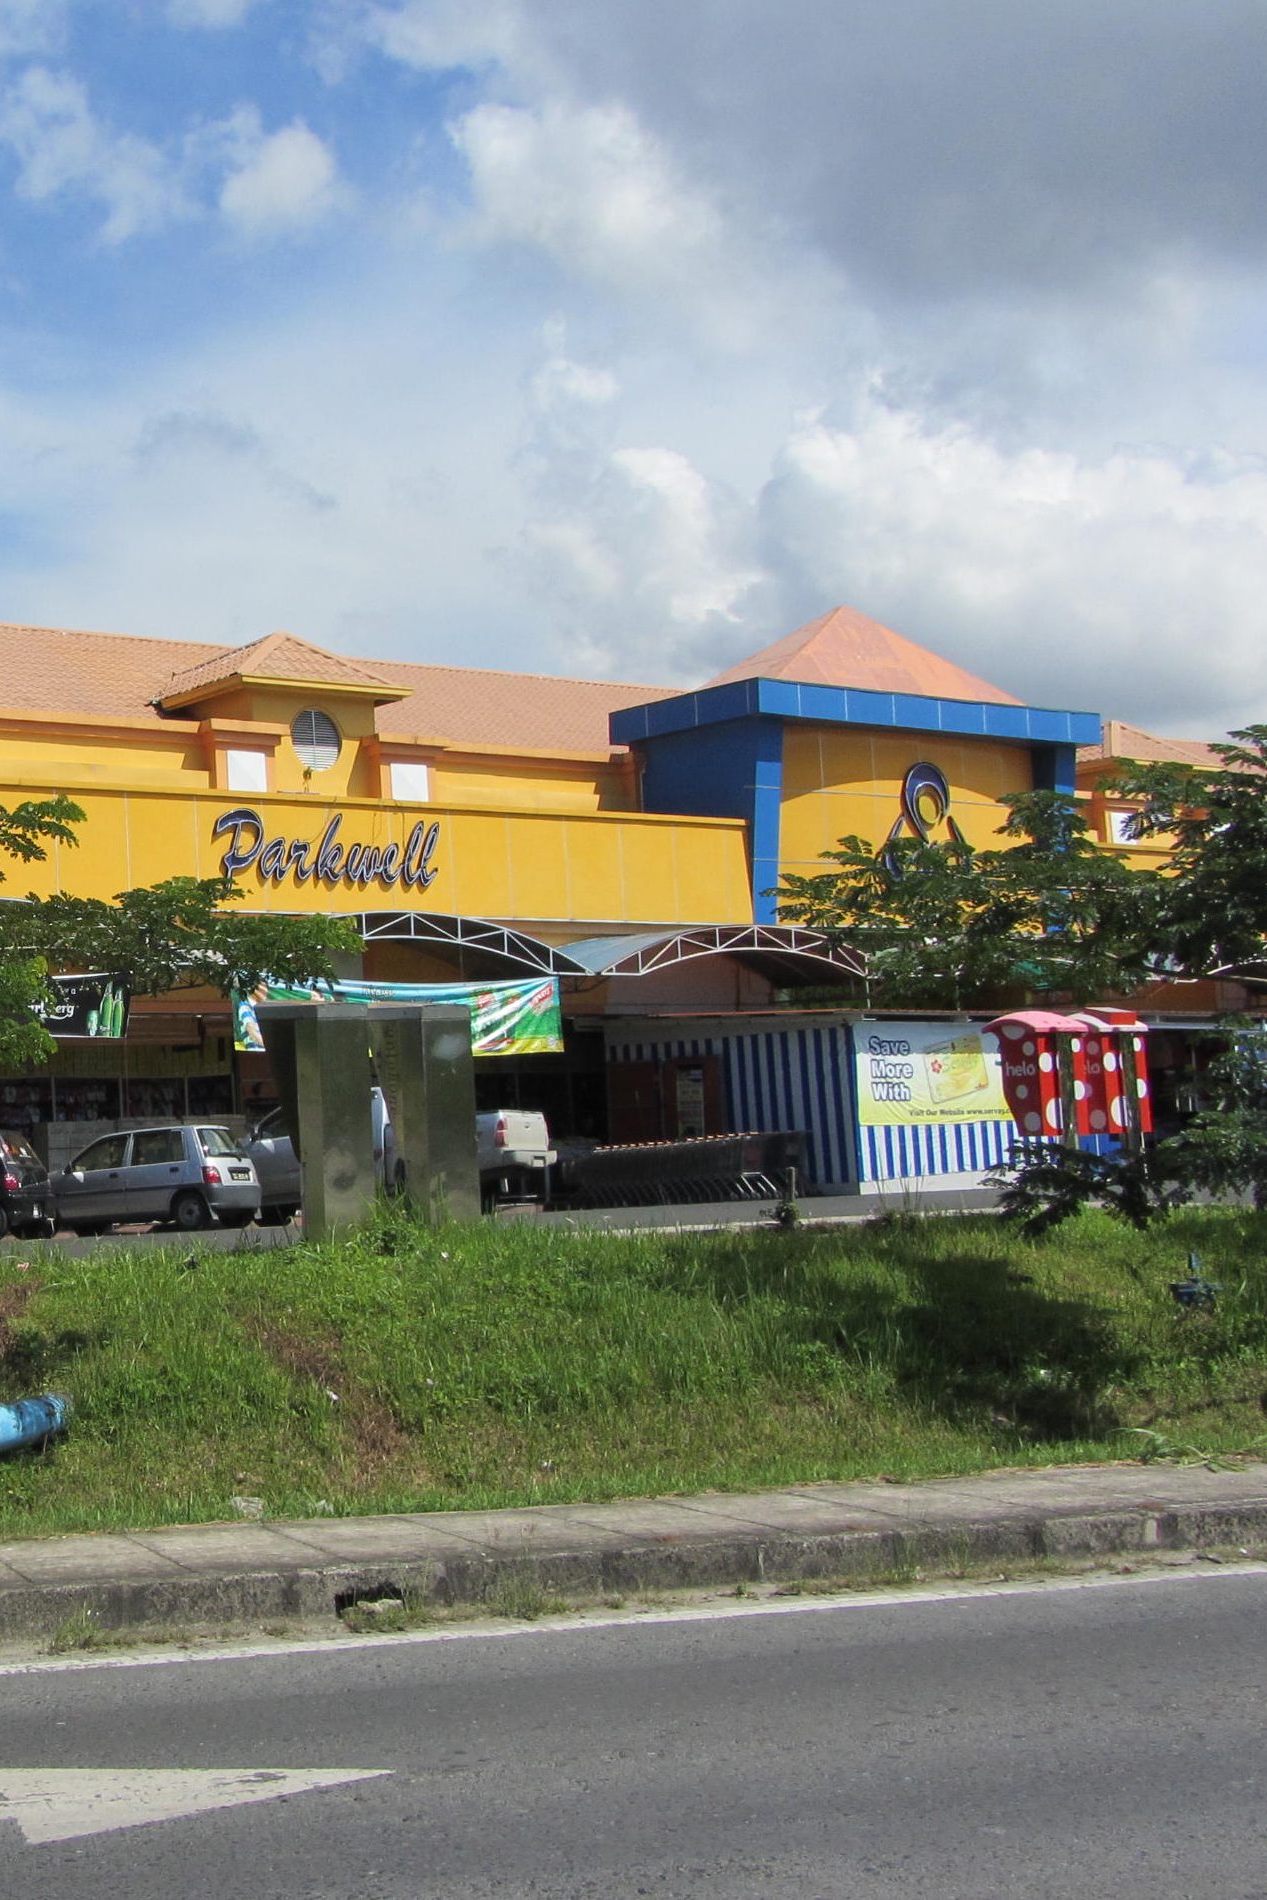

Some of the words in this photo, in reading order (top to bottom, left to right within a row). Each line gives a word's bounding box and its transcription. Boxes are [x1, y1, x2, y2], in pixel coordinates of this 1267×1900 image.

[216, 808, 440, 888] Parkwell
[868, 1035, 911, 1056] Save
[870, 1058, 914, 1079] More
[871, 1081, 912, 1102] With
[925, 1108, 938, 1117] Our
